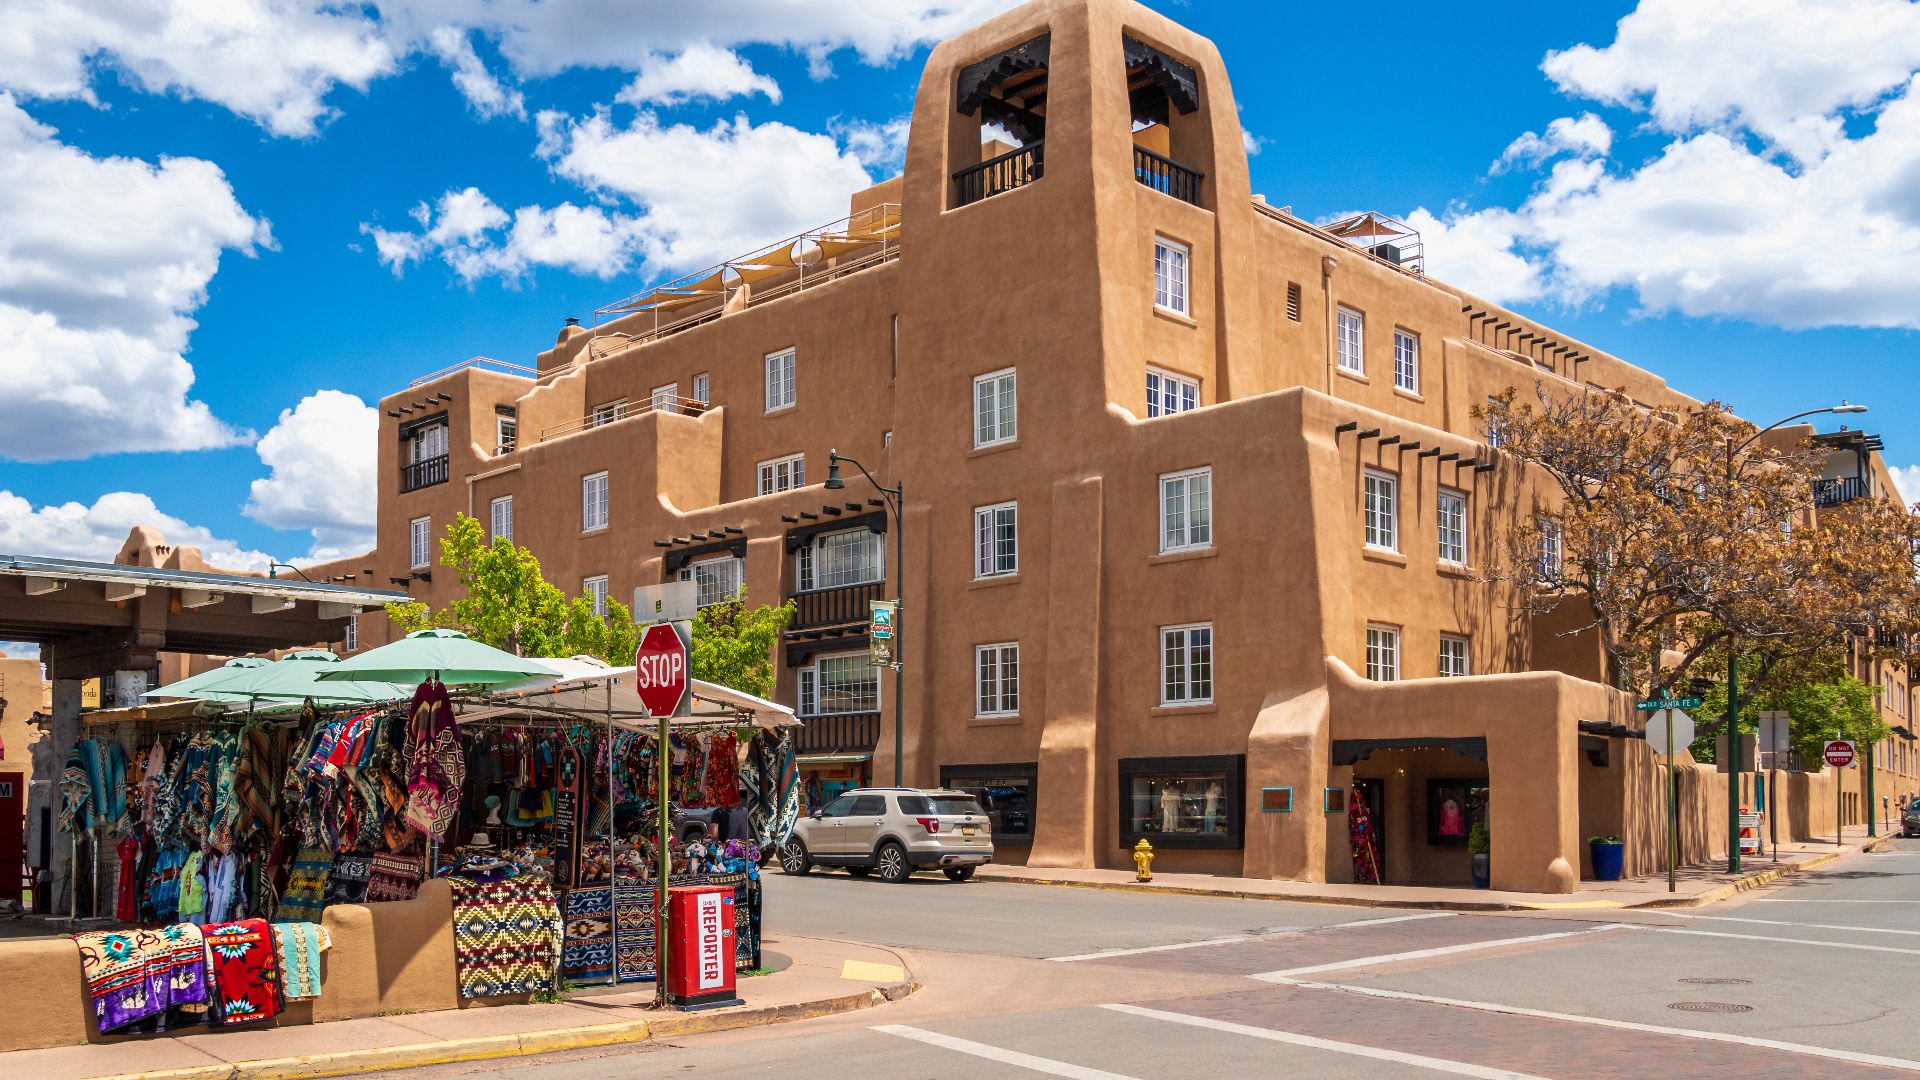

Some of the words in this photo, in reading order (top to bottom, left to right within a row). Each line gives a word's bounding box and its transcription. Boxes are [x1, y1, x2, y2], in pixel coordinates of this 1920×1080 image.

[640, 652, 682, 689] STOP
[1659, 700, 1680, 709] SANTA
[1682, 699, 1691, 707] FE
[703, 906, 718, 980] REPORTER
